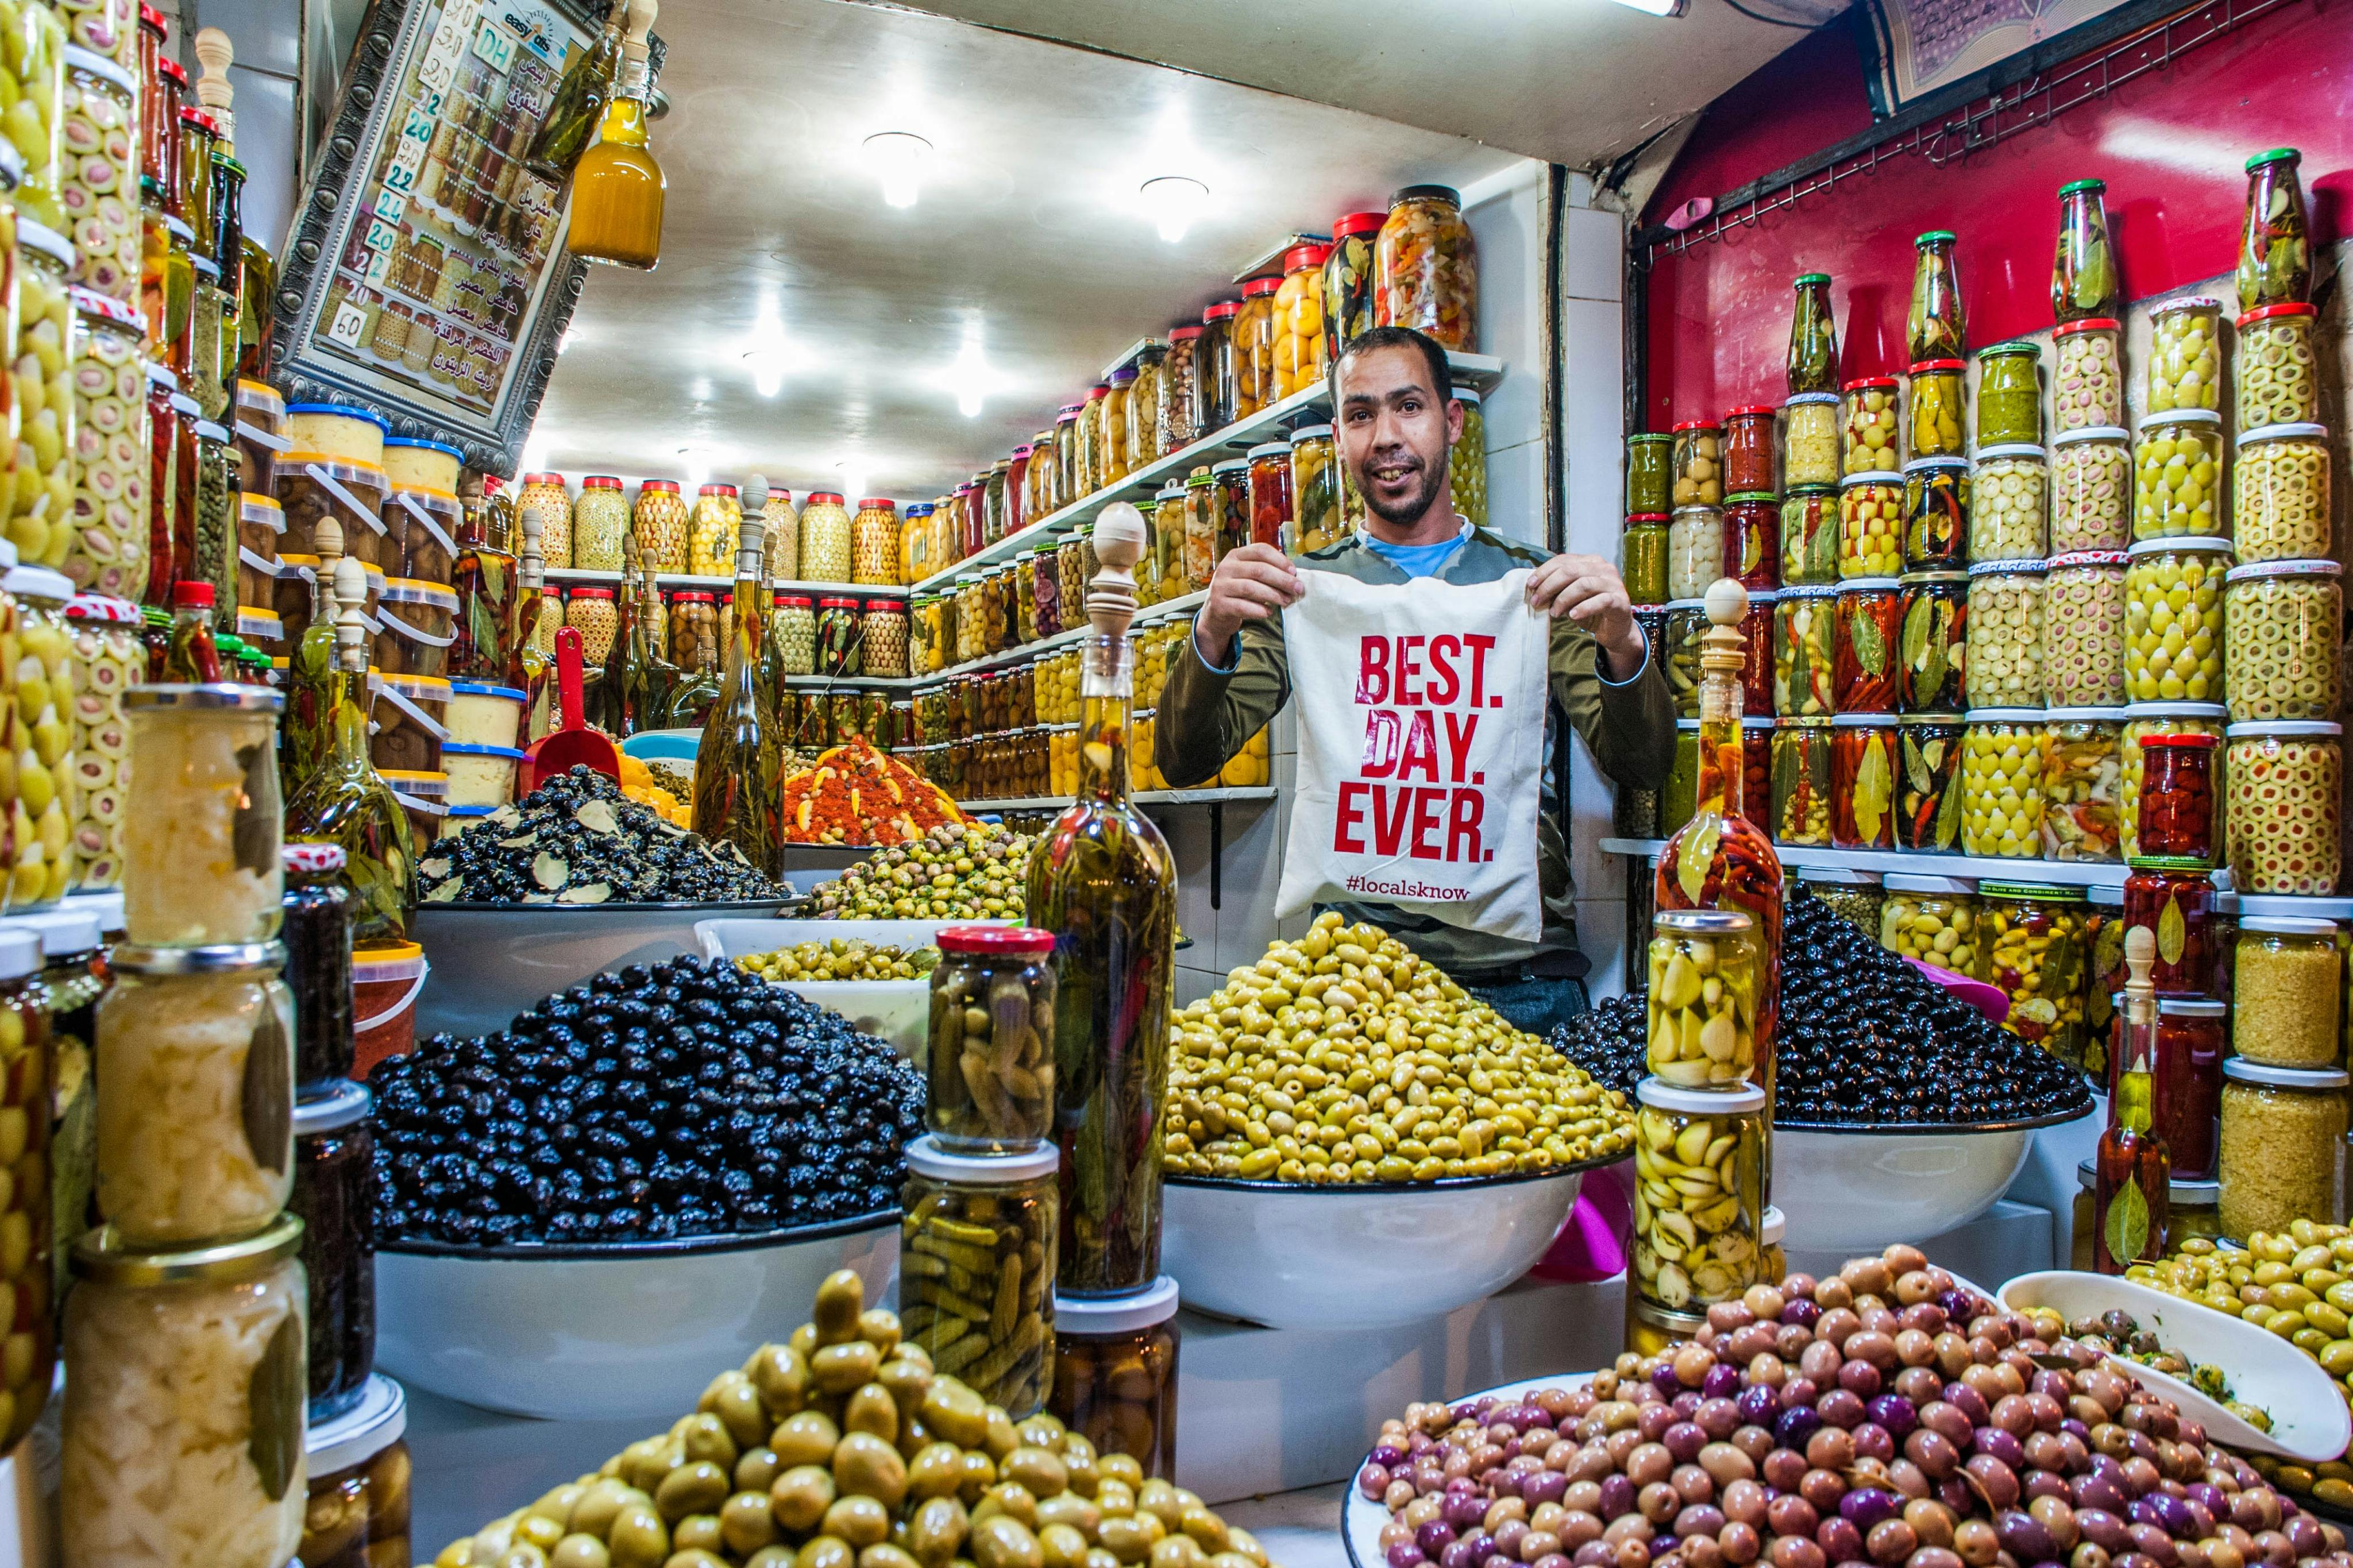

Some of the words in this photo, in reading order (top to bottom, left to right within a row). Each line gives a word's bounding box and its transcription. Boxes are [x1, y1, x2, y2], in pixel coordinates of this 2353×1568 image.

[505, 13, 533, 38] easy
[478, 28, 510, 68] DH
[405, 111, 431, 142] 20
[387, 165, 412, 192] 22
[377, 192, 400, 223] 24
[518, 188, 551, 219] مشرمل
[368, 224, 392, 251] 20
[480, 229, 511, 251] رومي
[524, 221, 543, 239] حار
[512, 242, 539, 264] أسود
[477, 257, 502, 278] بلدي
[504, 268, 530, 289] أسود
[345, 280, 369, 306] 20
[487, 291, 518, 315] حامض
[337, 313, 361, 337] 60
[477, 316, 509, 339] حامض
[433, 353, 471, 378] الزيتون
[473, 370, 496, 391] زيت
[1355, 634, 1503, 708] BEST.
[1361, 709, 1484, 785] DAY.
[1333, 782, 1494, 863] EVER.
[1346, 875, 1471, 901] #localsknow
